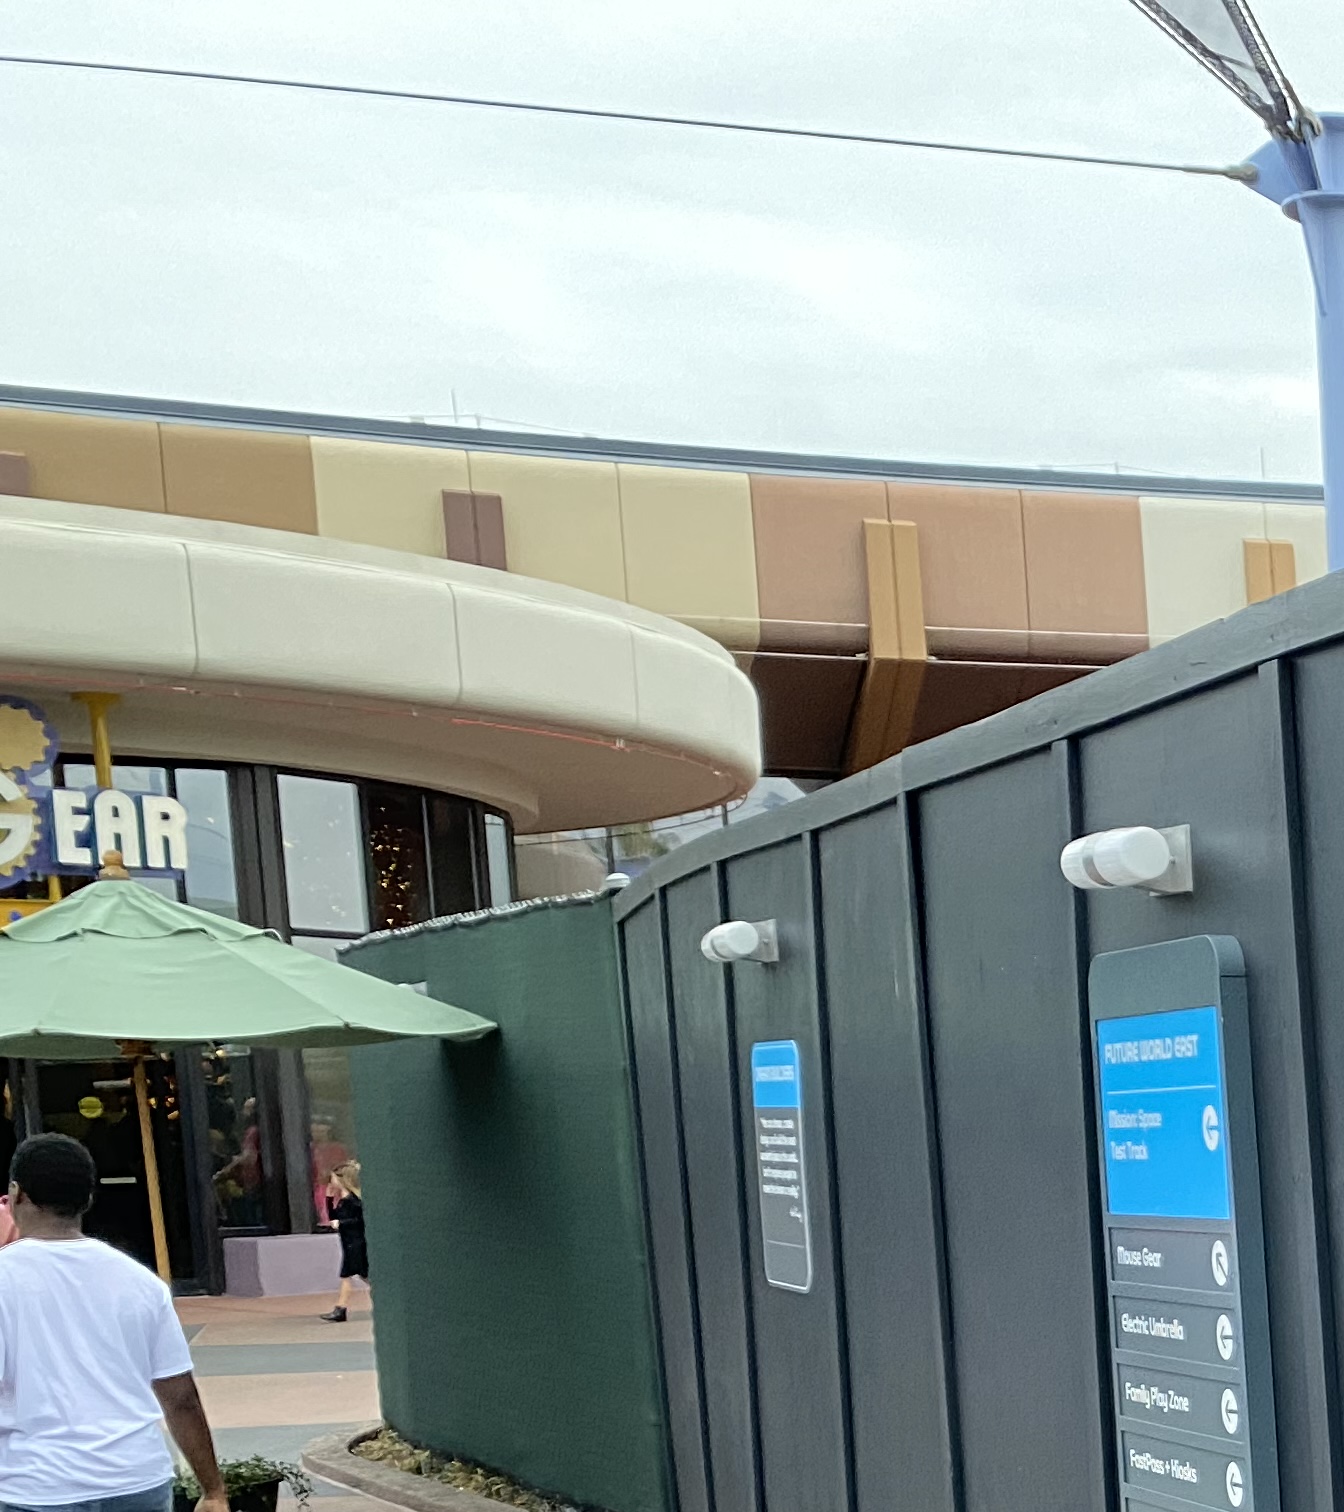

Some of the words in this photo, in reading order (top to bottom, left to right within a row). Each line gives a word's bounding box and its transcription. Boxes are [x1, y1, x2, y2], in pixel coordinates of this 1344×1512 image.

[1104, 1041, 1139, 1065] FUTURE
[1140, 1037, 1173, 1062] WORLD
[1174, 1034, 1199, 1058] EAST
[1116, 1245, 1142, 1266] Mouse
[1142, 1247, 1162, 1268] Gear
[1121, 1313, 1149, 1335] Electric
[1148, 1316, 1184, 1340] Umbrella
[1124, 1381, 1150, 1410] Family
[1150, 1386, 1169, 1413] Play
[1167, 1389, 1190, 1412] Zone
[1129, 1448, 1165, 1475] FastPass
